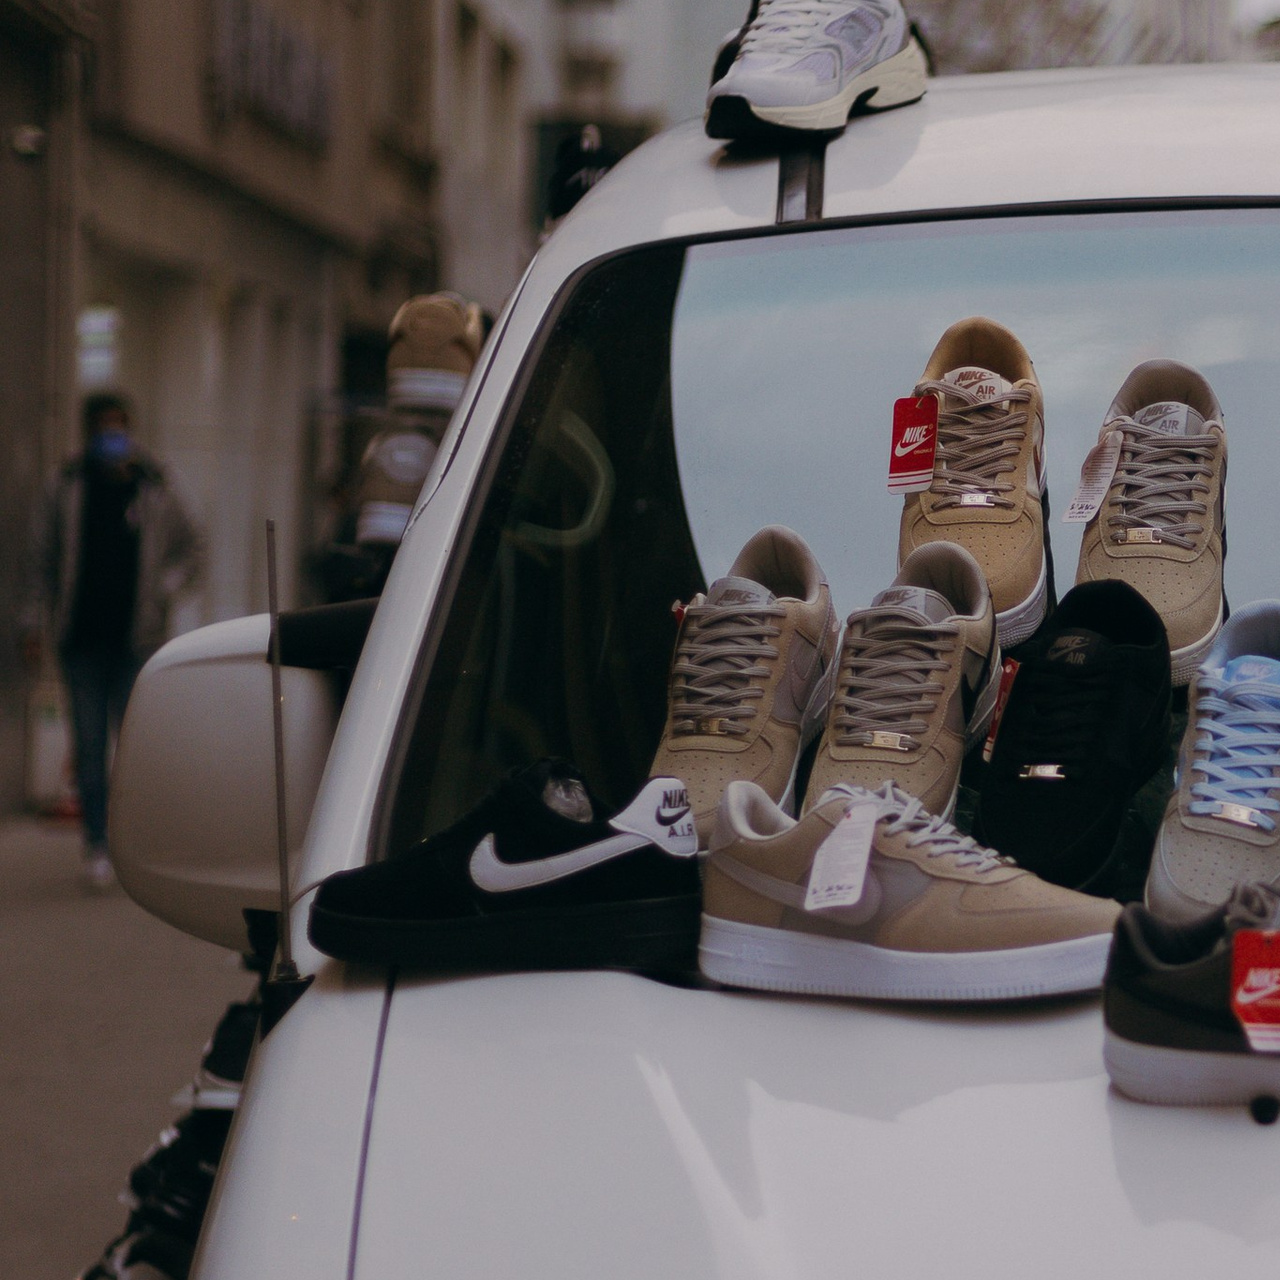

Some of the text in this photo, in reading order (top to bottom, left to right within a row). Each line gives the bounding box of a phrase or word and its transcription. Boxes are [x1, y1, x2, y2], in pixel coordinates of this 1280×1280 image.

[957, 370, 987, 383] NIKE
[976, 385, 996, 396] AIR
[1144, 404, 1174, 416] NIKE
[1158, 420, 1180, 431] AIR
[901, 425, 929, 444] NIKE
[1065, 652, 1087, 665] AIR
